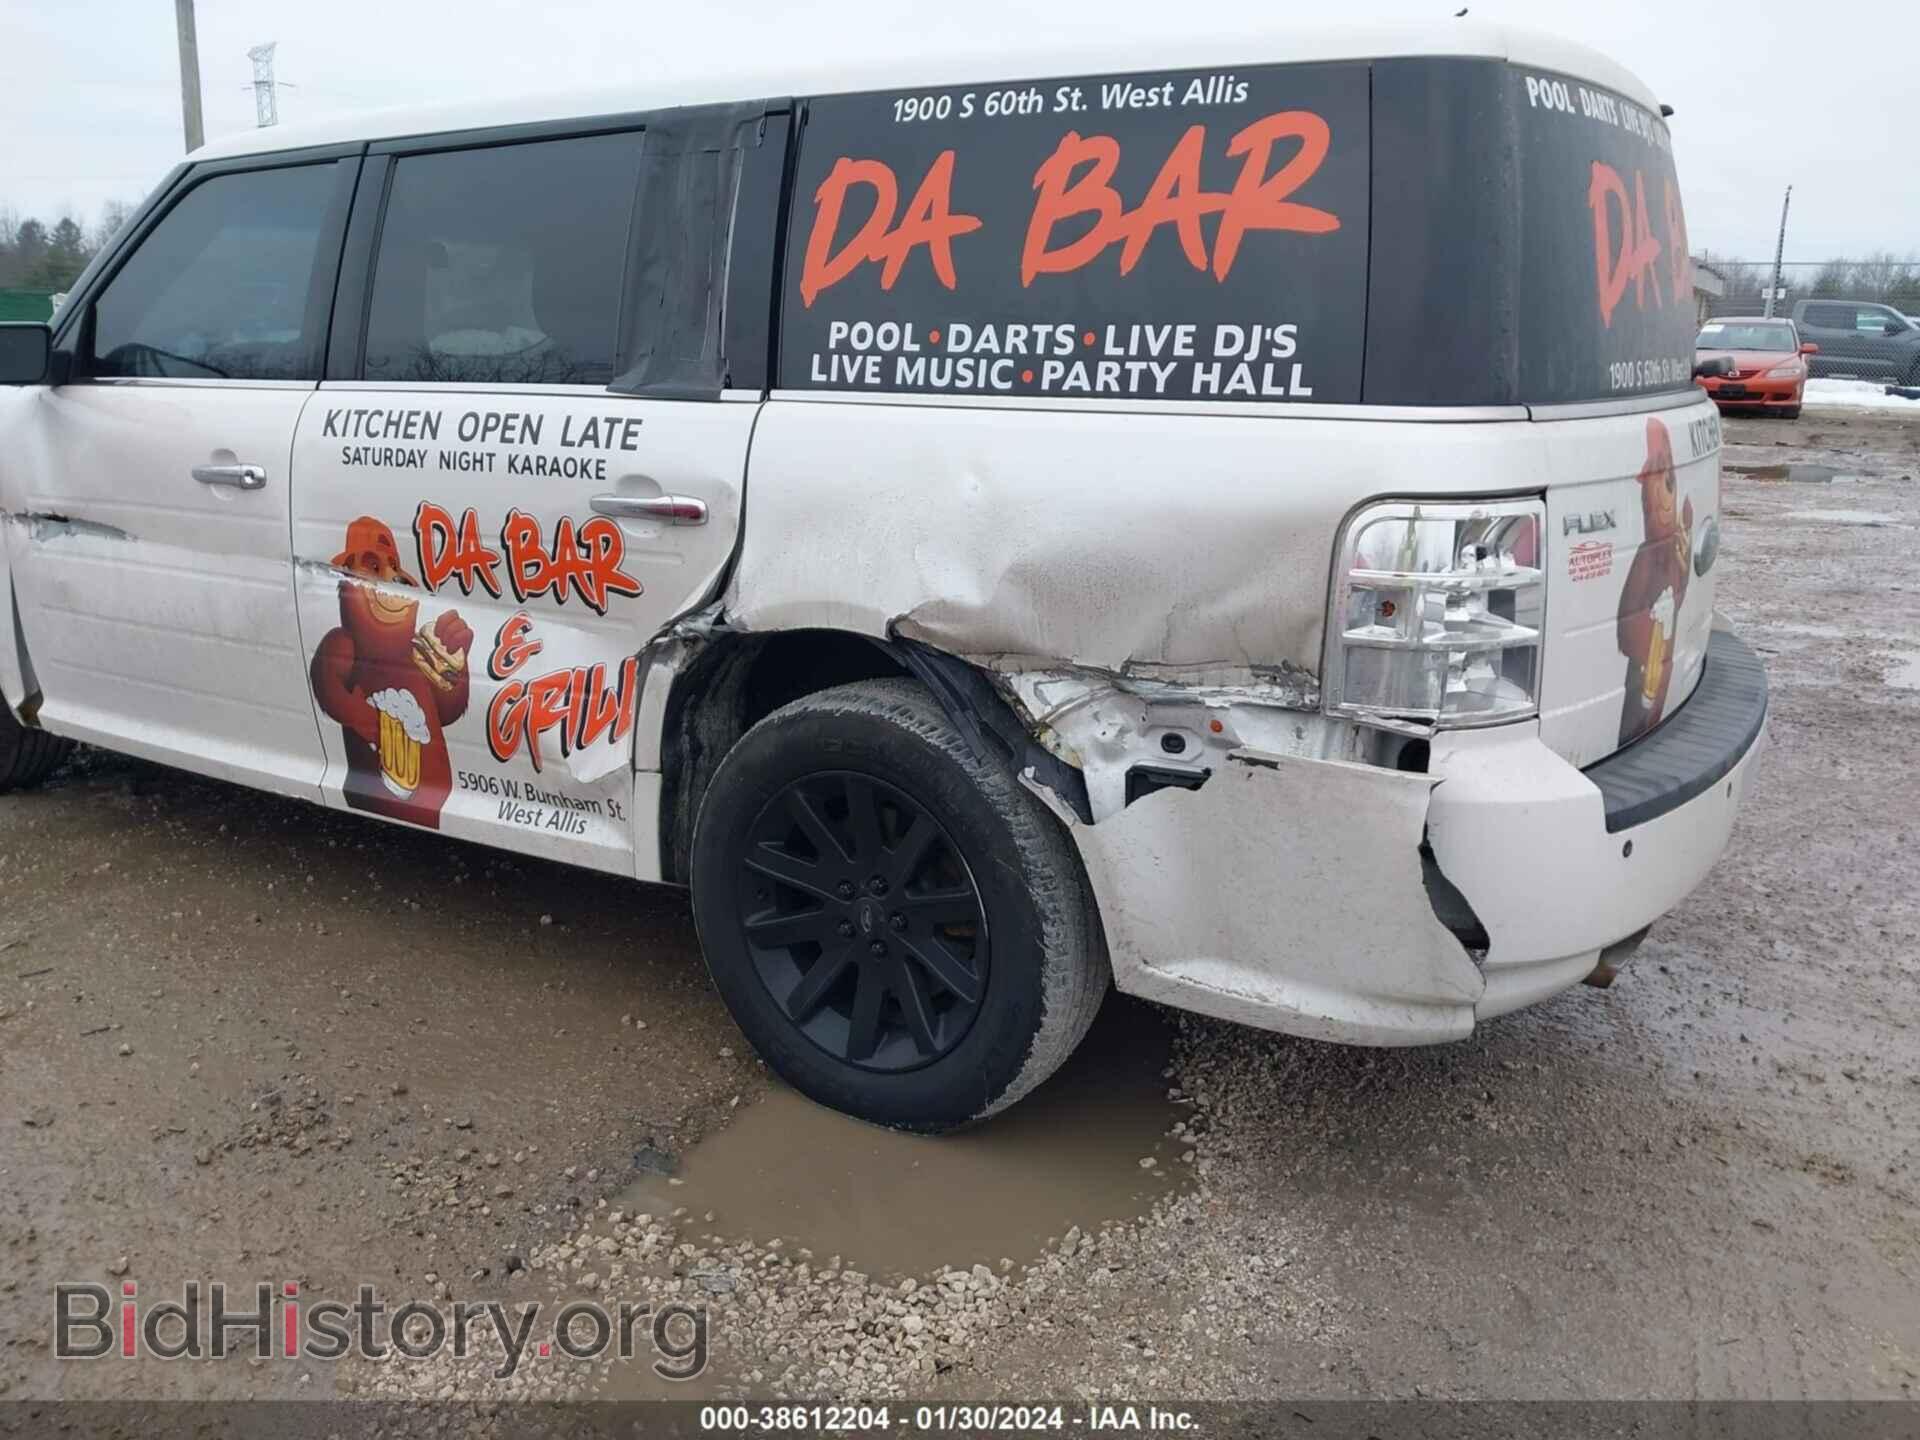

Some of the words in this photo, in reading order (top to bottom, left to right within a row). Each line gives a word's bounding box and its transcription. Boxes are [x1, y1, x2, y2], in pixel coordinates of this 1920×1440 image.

[893, 96, 951, 122] 1900
[959, 93, 975, 119] S
[984, 89, 1043, 116] 60th
[1053, 86, 1088, 113] St.
[1101, 82, 1173, 109] West
[1181, 76, 1249, 105] Allis
[1525, 76, 1576, 114] POOL
[1579, 87, 1618, 127] DARTS
[800, 150, 983, 308] DA
[1021, 110, 1341, 288] BAR
[1588, 160, 1662, 329] DA
[828, 321, 922, 352] POOL
[946, 323, 1077, 357] DARTS
[1103, 324, 1195, 357] LIVE
[1214, 324, 1298, 358] DJ'S
[811, 354, 882, 385] LIVE
[895, 356, 1014, 389] MUSIC
[1040, 360, 1178, 394] PARTY
[1192, 362, 1313, 396] HALL
[1609, 361, 1634, 390] 1900
[323, 408, 442, 441] KITCHEN
[458, 411, 544, 446] OPEN
[560, 415, 643, 451] LATE
[342, 445, 428, 469] SATURDAY
[439, 450, 497, 474] NIGHT
[507, 453, 607, 481] KARAOKE
[1563, 510, 1616, 536] FLEX
[413, 500, 502, 599] DA
[501, 507, 644, 616] BAR
[487, 610, 544, 681] &
[486, 655, 639, 773] GRILL
[458, 770, 499, 796] 5906
[501, 778, 521, 800] W.
[525, 783, 602, 814] Burnham
[608, 798, 626, 822] St.
[498, 801, 544, 827] West
[545, 810, 587, 835] Allis
